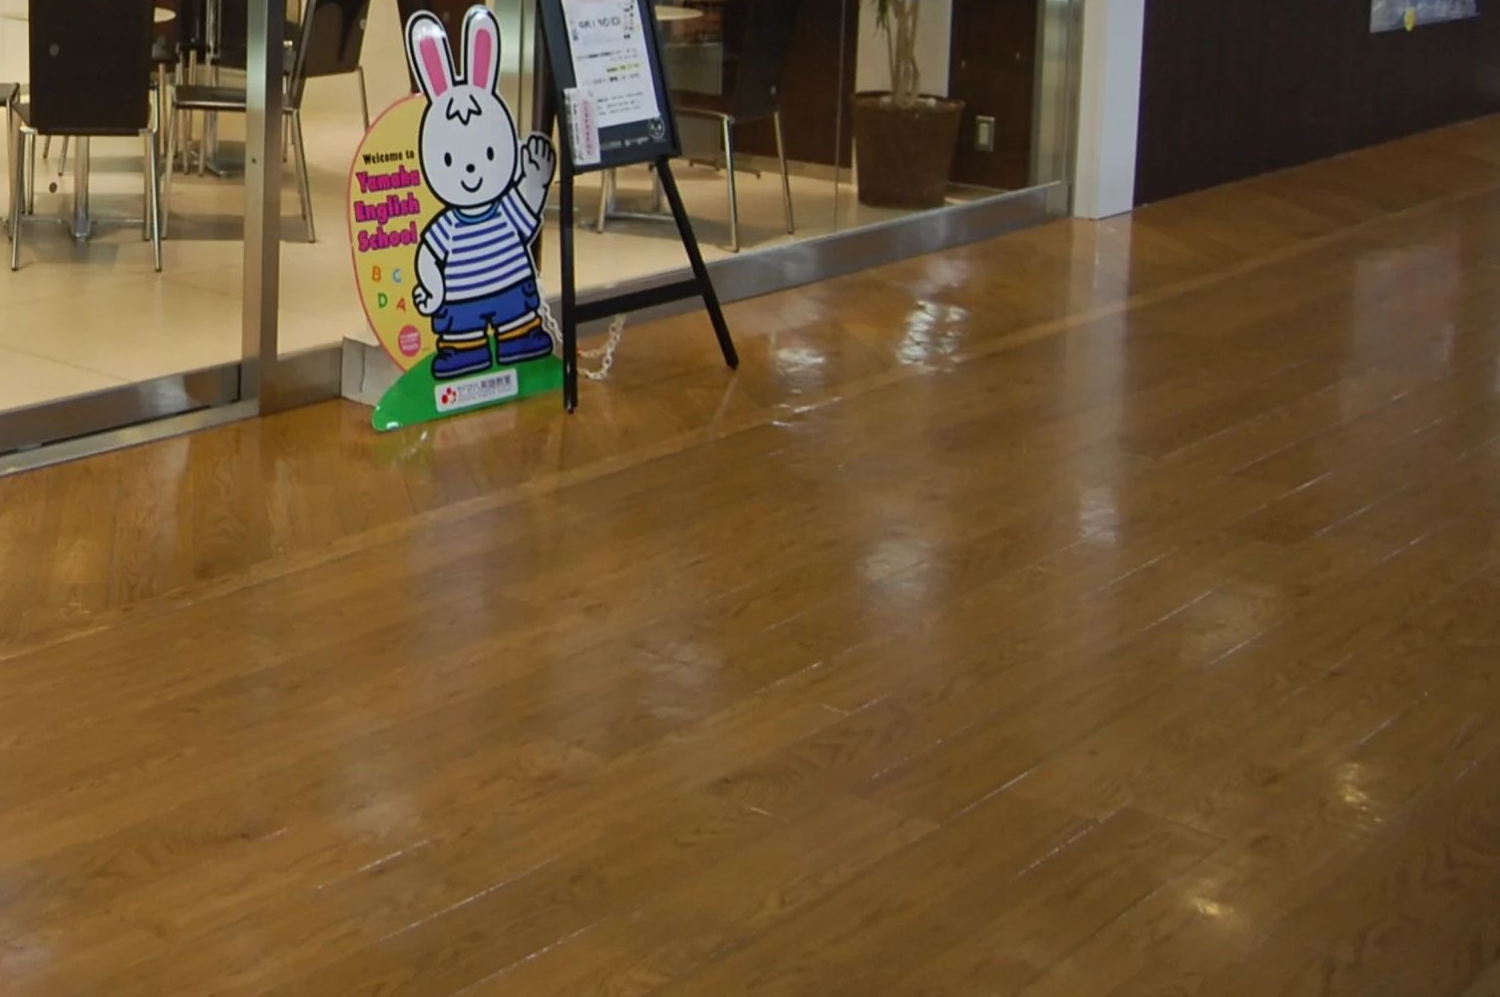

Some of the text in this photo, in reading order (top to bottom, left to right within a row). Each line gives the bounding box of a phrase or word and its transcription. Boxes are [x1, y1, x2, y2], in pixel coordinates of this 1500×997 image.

[362, 150, 415, 166] Welcome to
[356, 165, 421, 194] Yamaha
[354, 192, 421, 225] English
[357, 221, 418, 252] School
[372, 265, 403, 283] B C
[378, 293, 406, 312] D A
